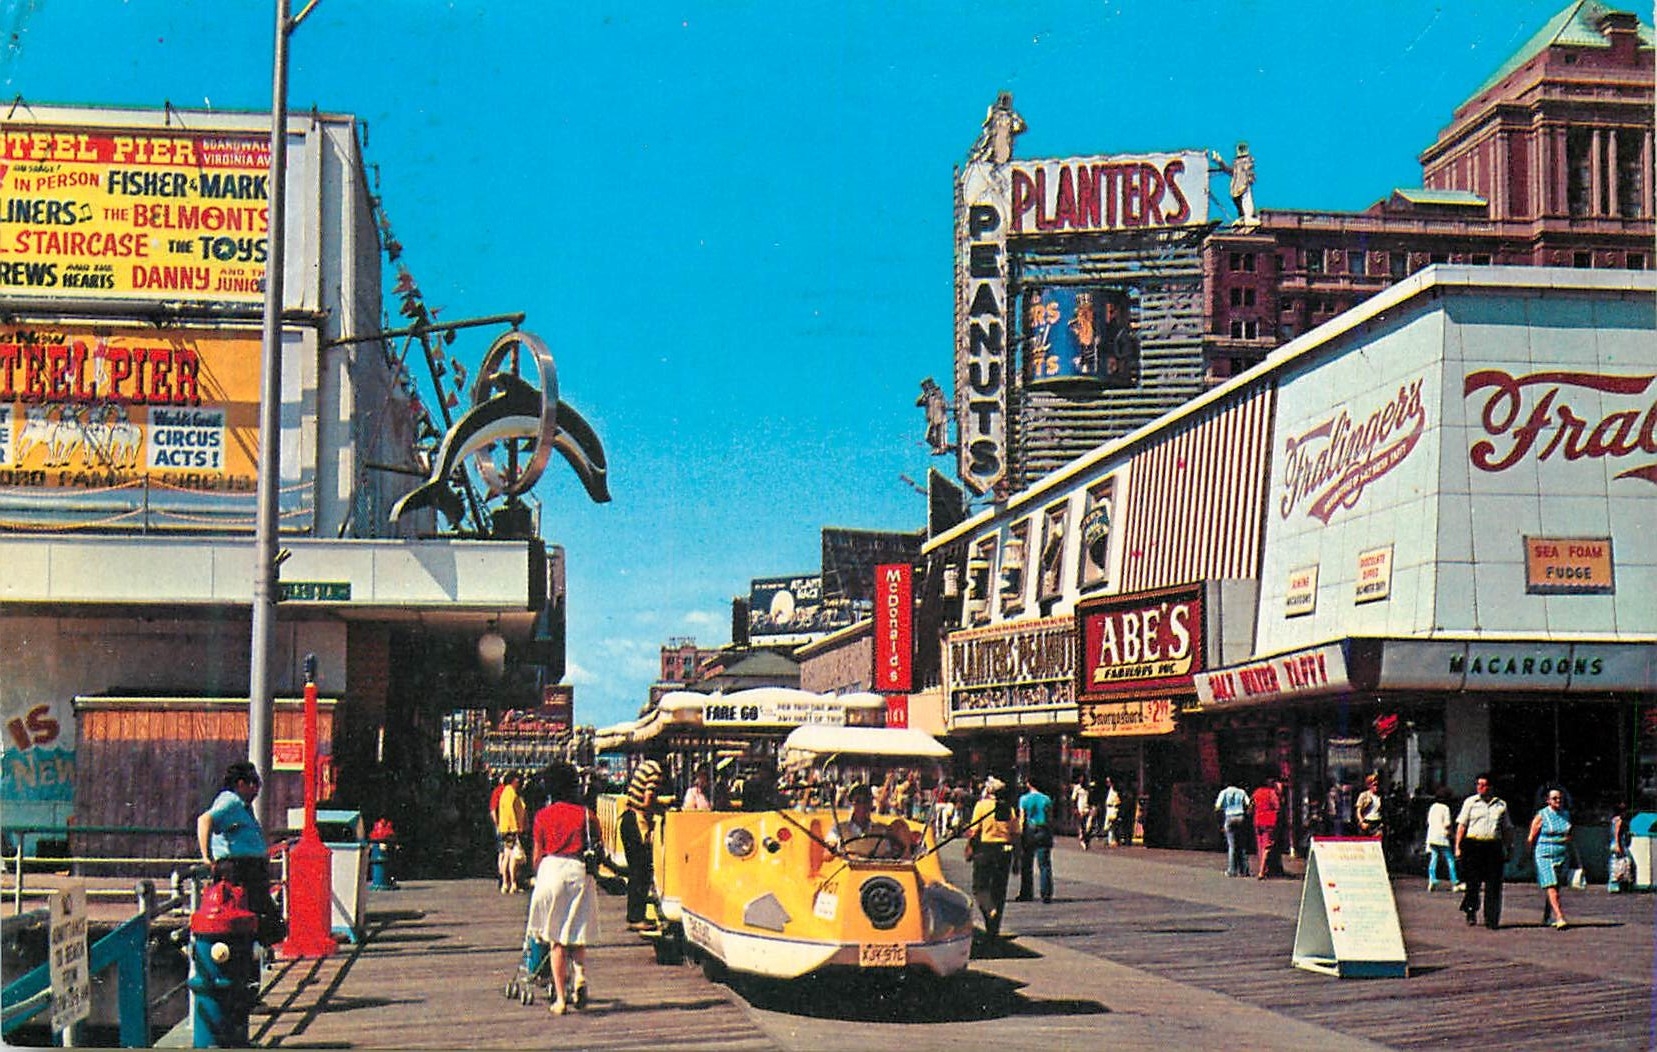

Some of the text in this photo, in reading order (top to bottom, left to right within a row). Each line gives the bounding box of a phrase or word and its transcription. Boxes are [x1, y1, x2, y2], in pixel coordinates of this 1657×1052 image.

[0, 132, 197, 164] TEEL PIER
[203, 153, 252, 167] VIRGINIA
[14, 171, 100, 192] IN PERSON
[108, 169, 269, 199] FISHER & MARK
[1010, 159, 1191, 231] PLANTERS
[104, 203, 268, 232] THE BELMONTS
[14, 229, 149, 258] STAIRCASE
[168, 235, 268, 263] THE TOYS
[62, 273, 115, 289] HEARTS
[132, 264, 210, 290] DANNY
[220, 268, 245, 277] AND
[969, 203, 1002, 477] PEANUTS
[106, 346, 201, 404] PIER
[153, 429, 220, 447] CIRCUS
[1281, 378, 1423, 520] Fralinger's
[1534, 545, 1604, 558] SEA FOAM
[1545, 565, 1593, 580] FUDGE
[886, 568, 902, 682] McDonald's
[1098, 602, 1190, 668] ABE'S
[1283, 652, 1329, 690] TAFFY
[1449, 655, 1604, 676] MACAROONS
[705, 704, 738, 721] FARE
[8, 703, 61, 752] IS
